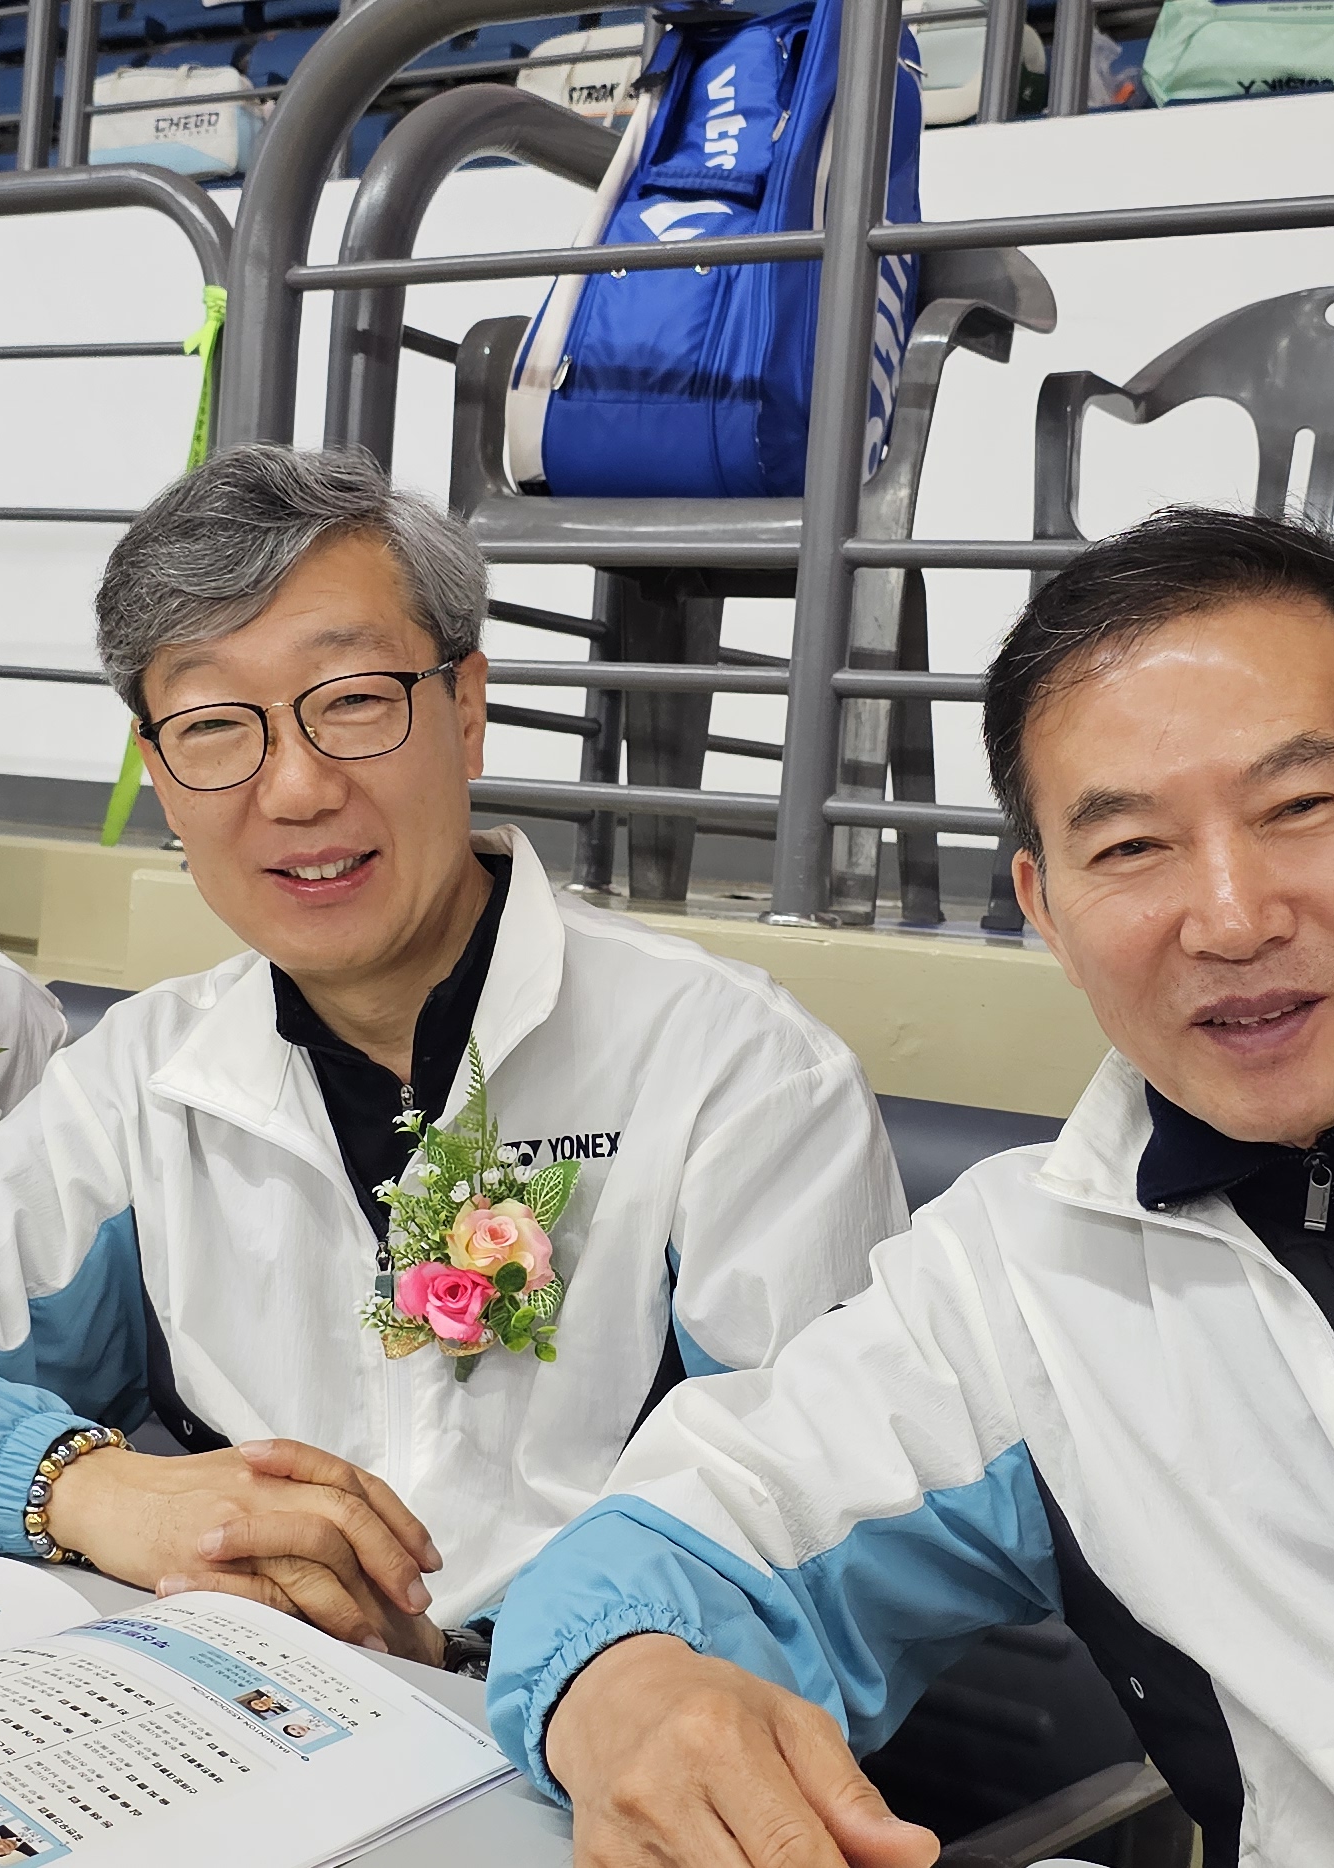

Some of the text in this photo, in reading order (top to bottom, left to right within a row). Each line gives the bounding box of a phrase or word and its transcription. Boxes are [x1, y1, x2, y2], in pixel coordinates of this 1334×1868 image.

[547, 1131, 621, 1162] YONEX
[190, 1685, 292, 1755] BADMINTON ASSOCIATION
[36, 1806, 86, 1843] 강변우리클럽
